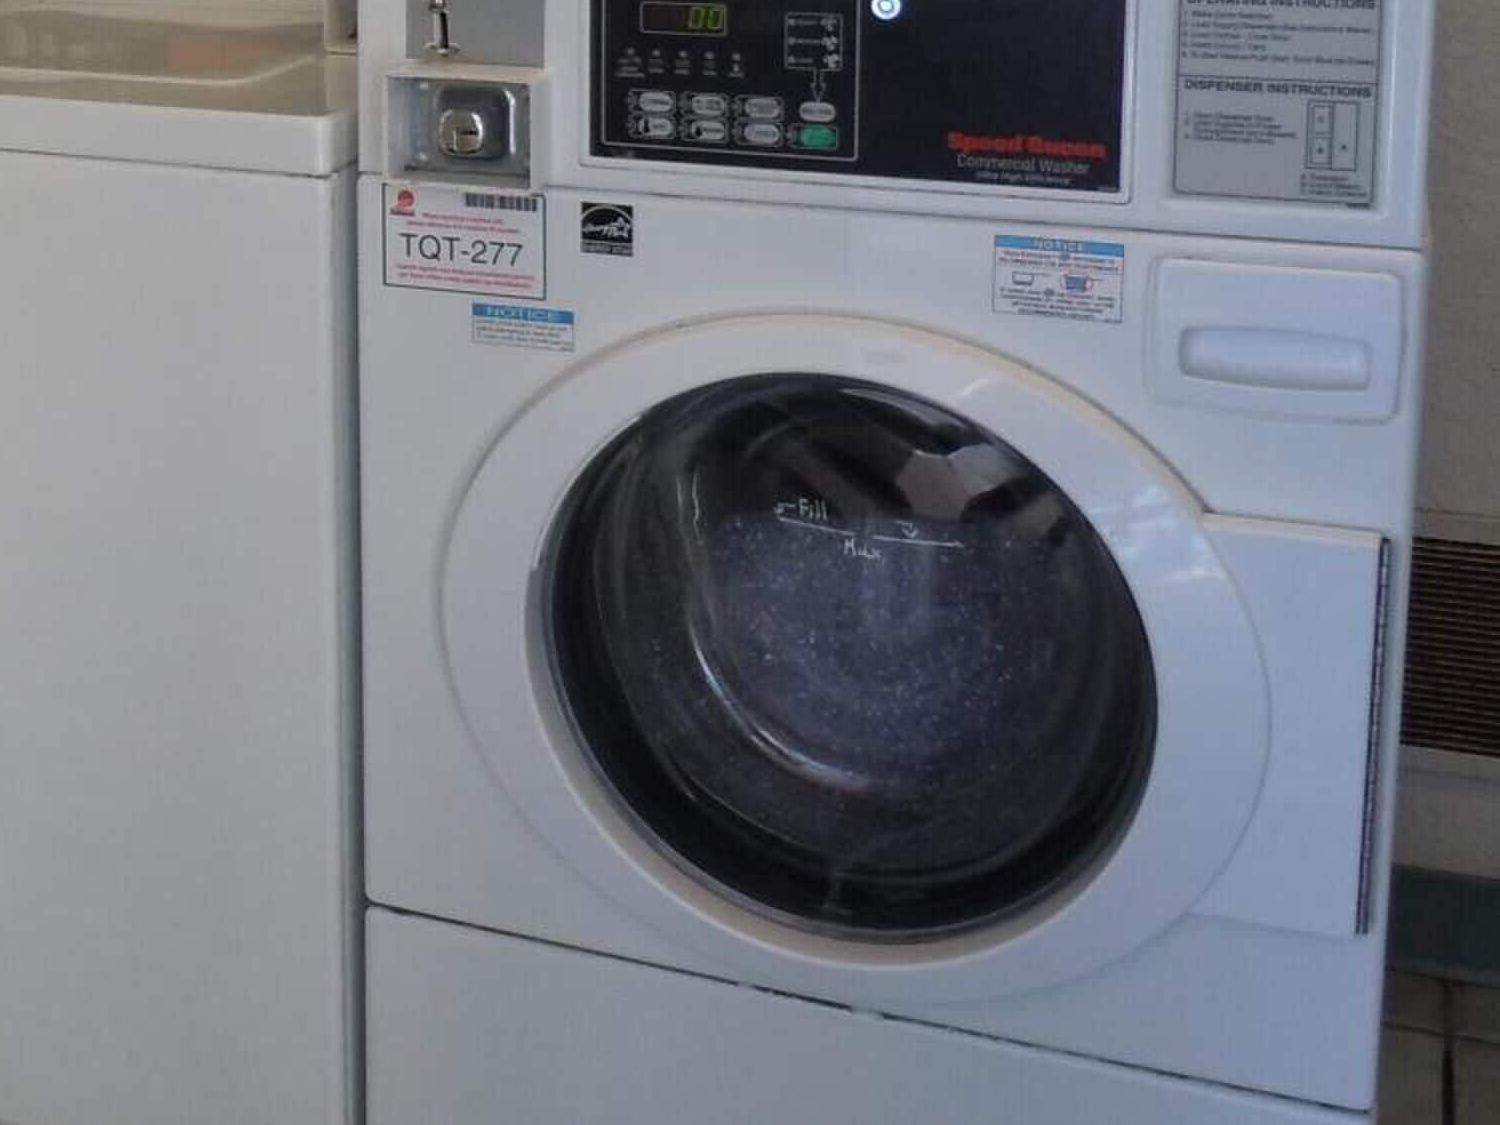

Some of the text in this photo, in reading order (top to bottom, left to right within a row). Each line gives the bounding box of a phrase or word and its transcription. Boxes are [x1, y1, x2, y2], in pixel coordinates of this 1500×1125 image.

[1184, 79, 1372, 98] DISPENSER INSTRUCTIONS
[956, 154, 1092, 175] Commercial Washer
[399, 232, 523, 267] TQT-277
